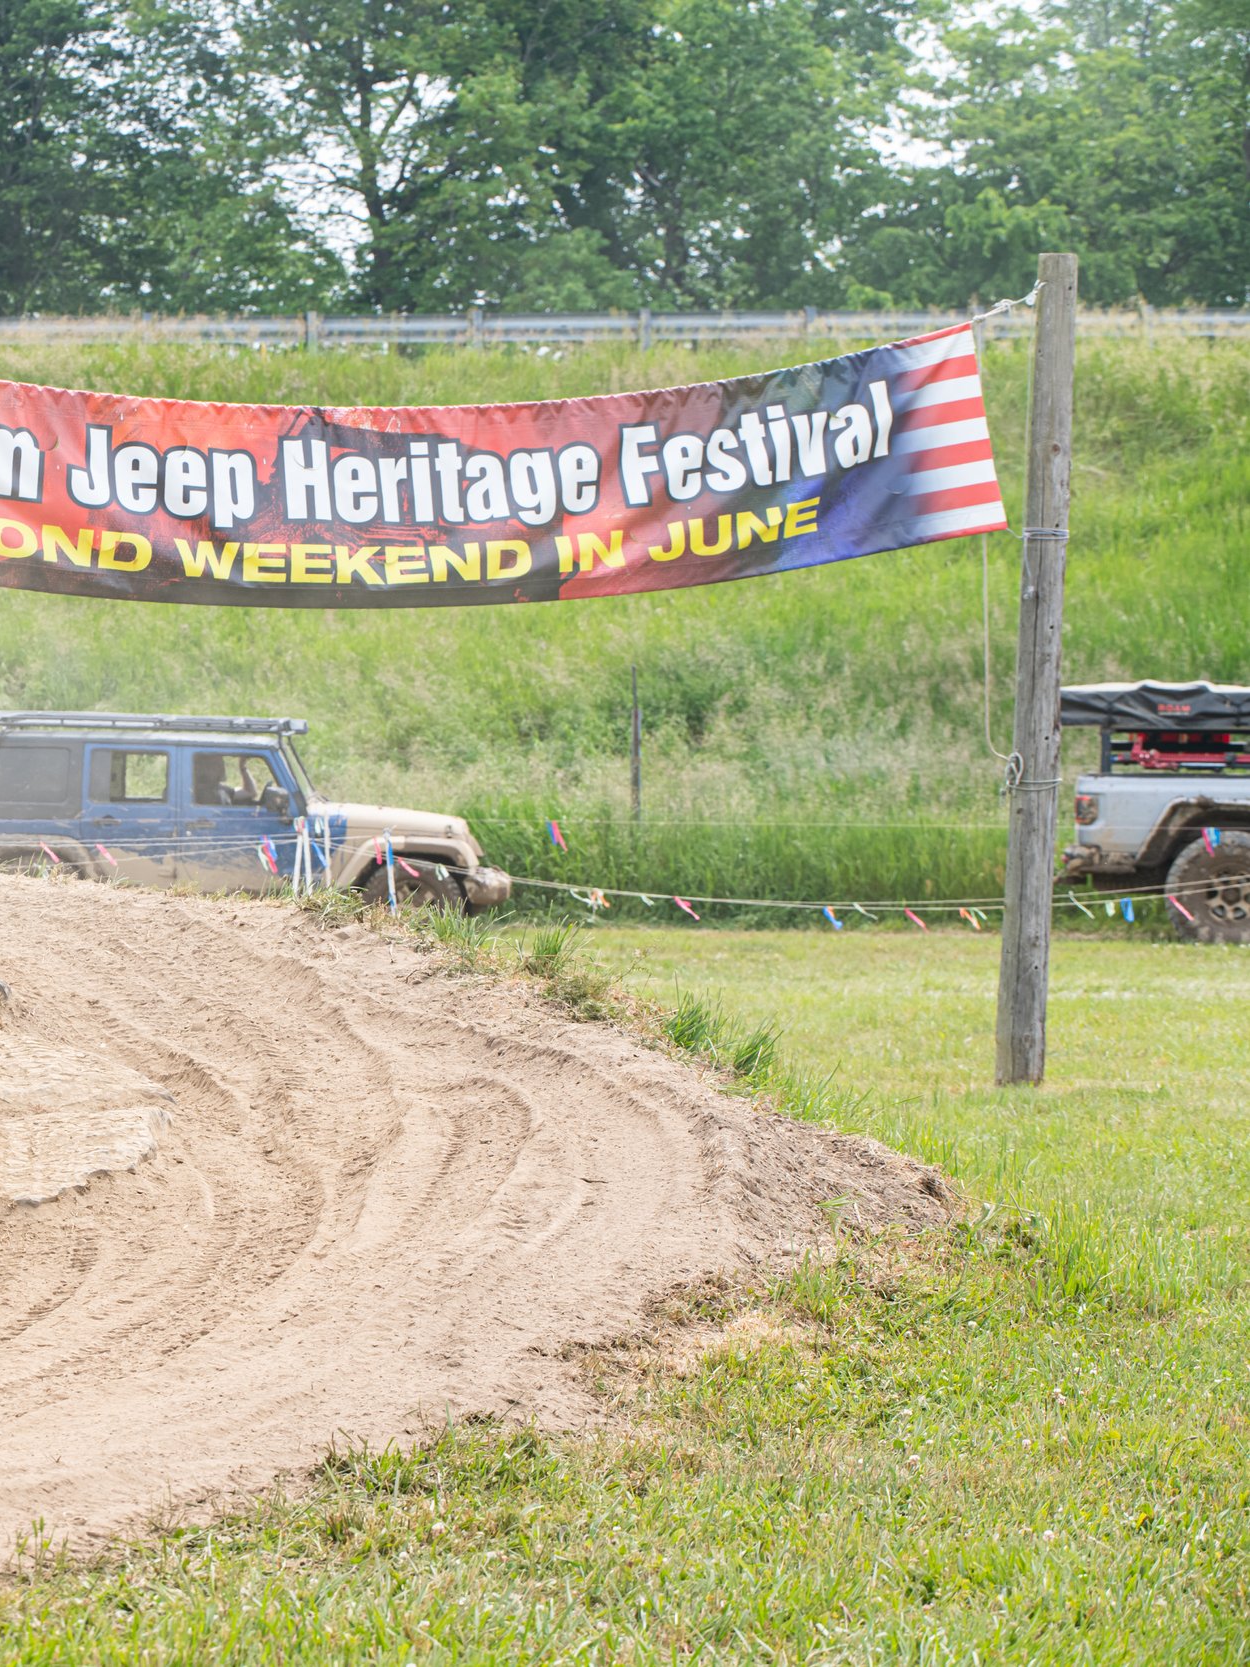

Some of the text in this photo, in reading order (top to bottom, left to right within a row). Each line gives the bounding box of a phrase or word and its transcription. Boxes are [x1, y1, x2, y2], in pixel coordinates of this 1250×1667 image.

[71, 427, 255, 528] Jeep
[282, 438, 598, 525] Heritage
[621, 380, 894, 505] Festival
[175, 538, 531, 585] WEEKEND
[555, 529, 626, 574] IN
[648, 496, 821, 563] JUNE
